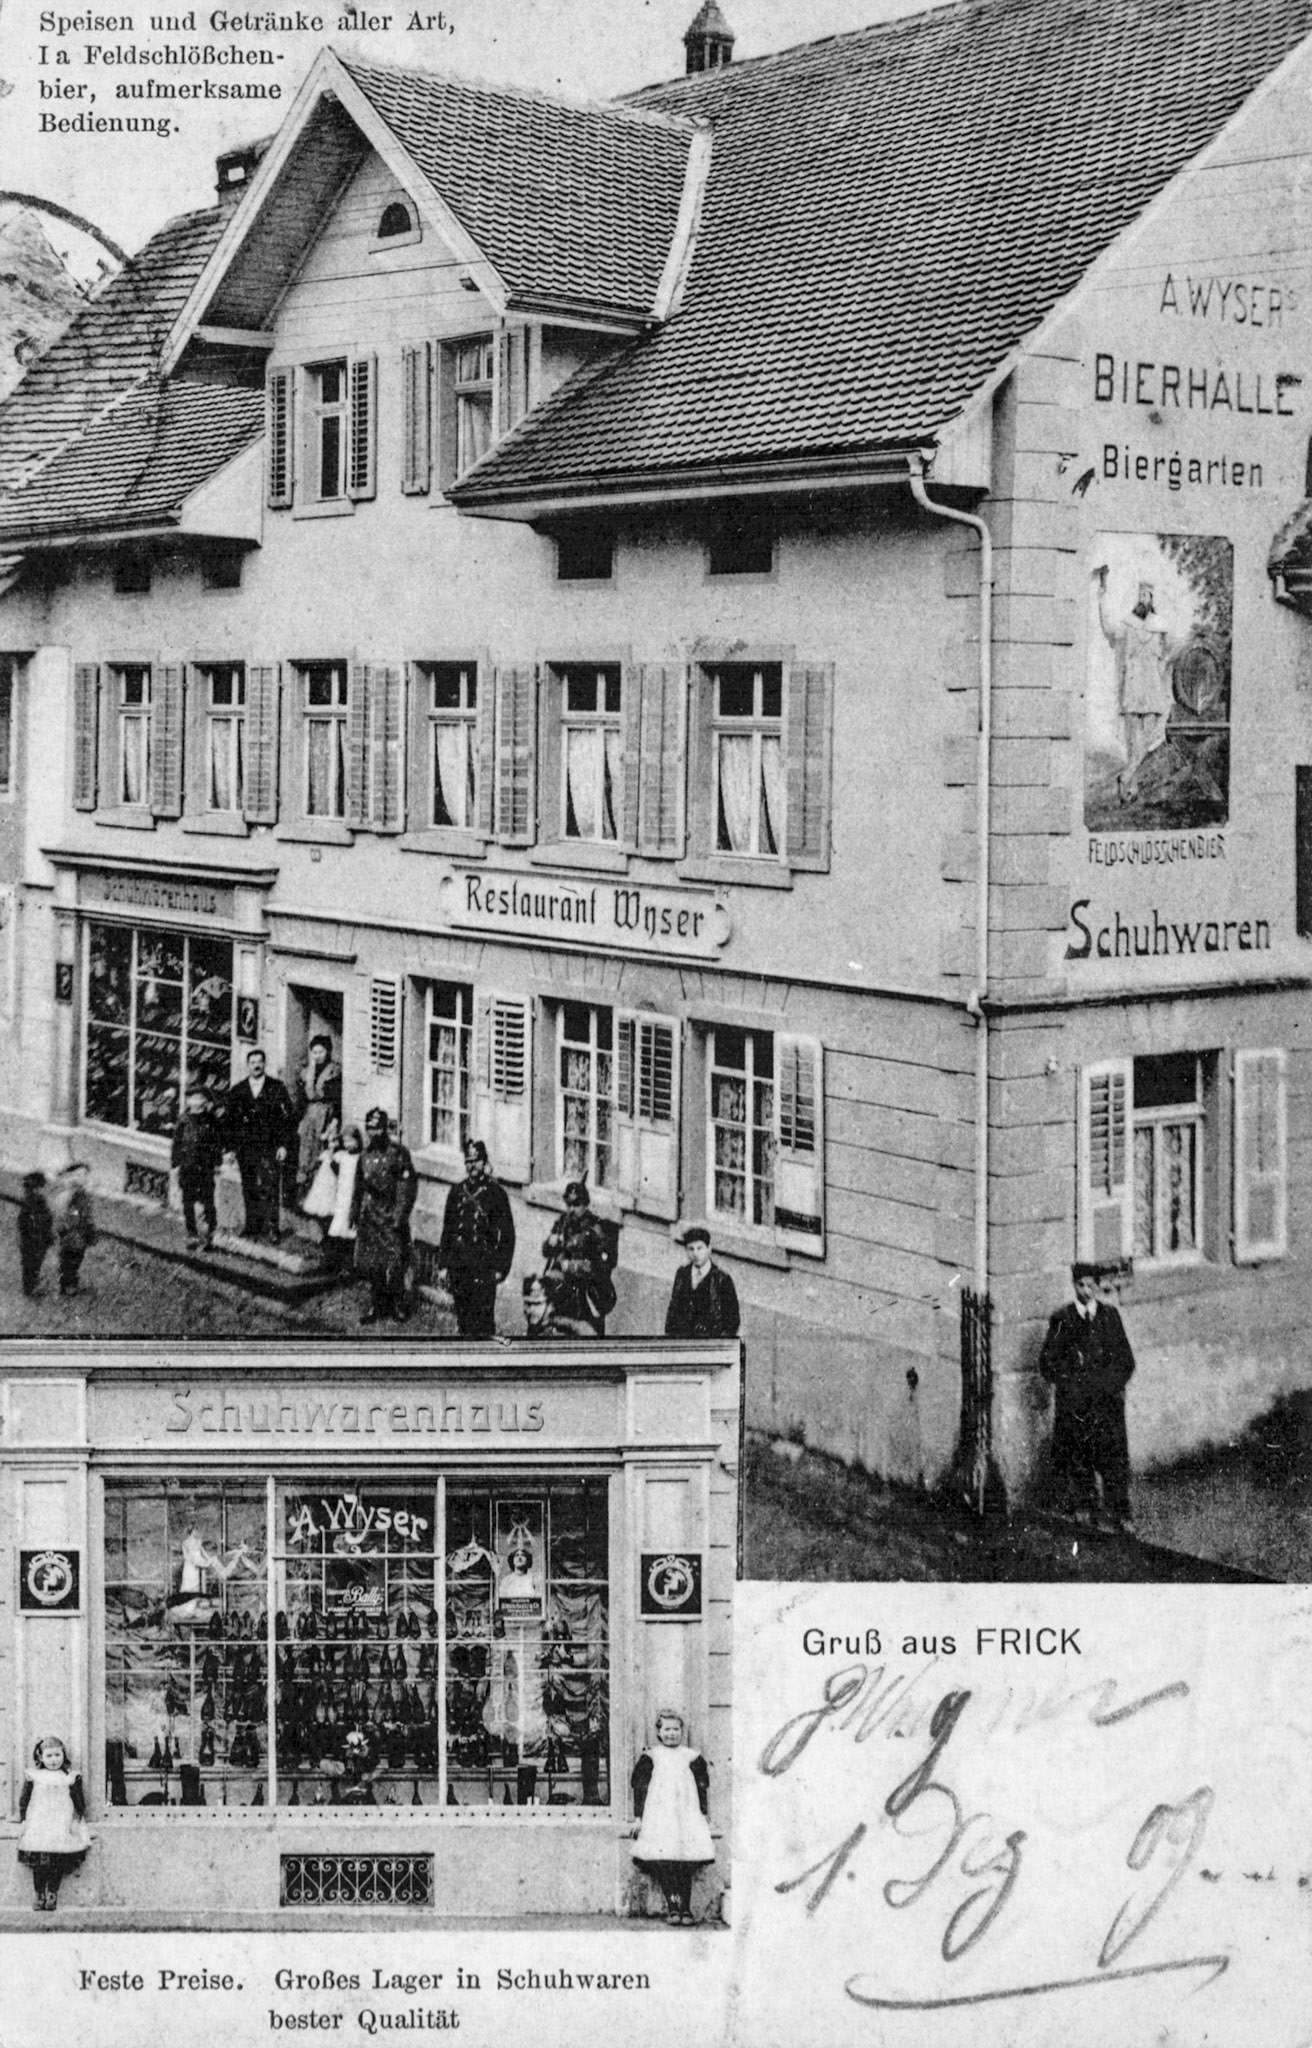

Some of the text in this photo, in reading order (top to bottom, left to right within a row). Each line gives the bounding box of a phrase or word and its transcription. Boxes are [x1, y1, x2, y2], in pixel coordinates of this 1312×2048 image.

[1095, 353, 1300, 416] BIERHALLE
[1103, 444, 1263, 491] Biergarten
[465, 874, 598, 926] Restaurant
[1063, 899, 1272, 960] Schuhwaren
[166, 1388, 545, 1432] Schuhwarenhaus
[321, 1493, 429, 1545] Wyser
